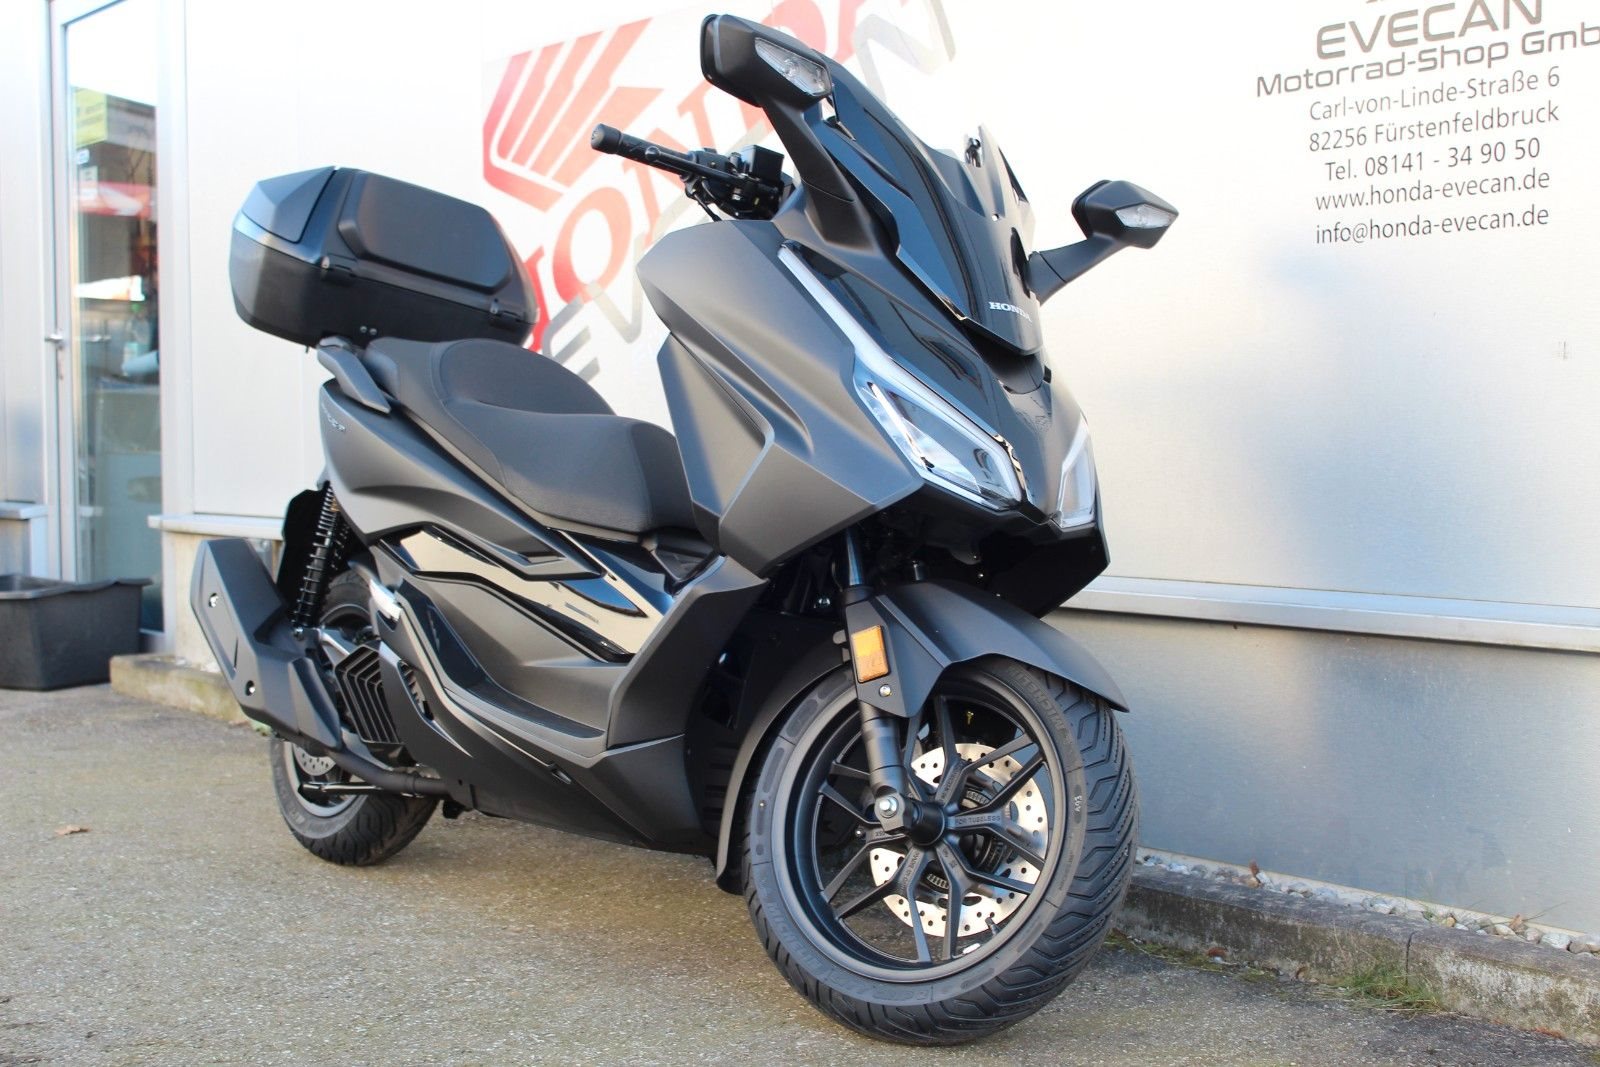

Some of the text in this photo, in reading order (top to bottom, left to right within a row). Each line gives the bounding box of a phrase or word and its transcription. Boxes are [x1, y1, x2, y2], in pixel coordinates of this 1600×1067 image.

[1316, 0, 1543, 60] EVECAN
[1256, 40, 1510, 99] Motorrad-Shop
[1309, 65, 1561, 121] Carl-von-Linde-Straße 6
[1308, 99, 1561, 153] 82256 Fürstenfeldbruck
[1324, 159, 1359, 182] Tel.
[1364, 151, 1424, 177] 08141
[1447, 144, 1473, 168] 34
[1479, 140, 1507, 165] 90
[1513, 136, 1541, 161] 50
[1314, 166, 1551, 211] www.honda-evecan.de
[1315, 203, 1550, 244] info@honda-evecan.de
